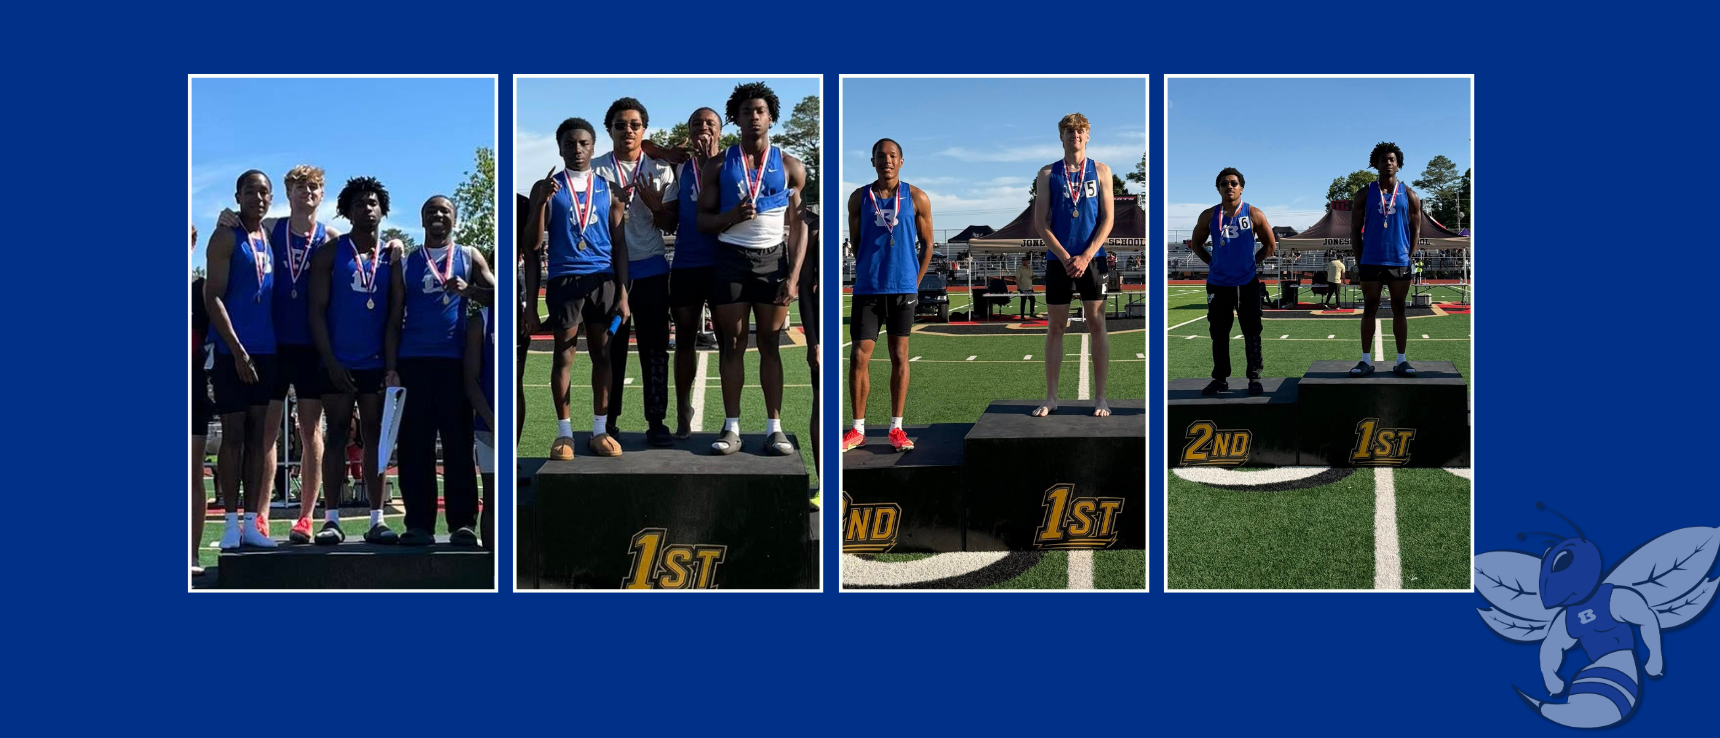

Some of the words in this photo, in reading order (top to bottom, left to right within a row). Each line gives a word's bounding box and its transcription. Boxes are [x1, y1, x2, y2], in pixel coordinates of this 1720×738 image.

[1086, 181, 1095, 197] 5
[874, 209, 899, 227] B
[1241, 217, 1249, 229] 6
[1020, 239, 1046, 247] JONE
[1108, 238, 1146, 247] SCHOOL
[1322, 238, 1352, 246] JONES
[1182, 420, 1252, 462] 2ND
[1350, 418, 1416, 461] 1ST
[843, 500, 901, 541] ND
[1035, 484, 1124, 543] 1ST
[622, 529, 726, 588] 1ST
